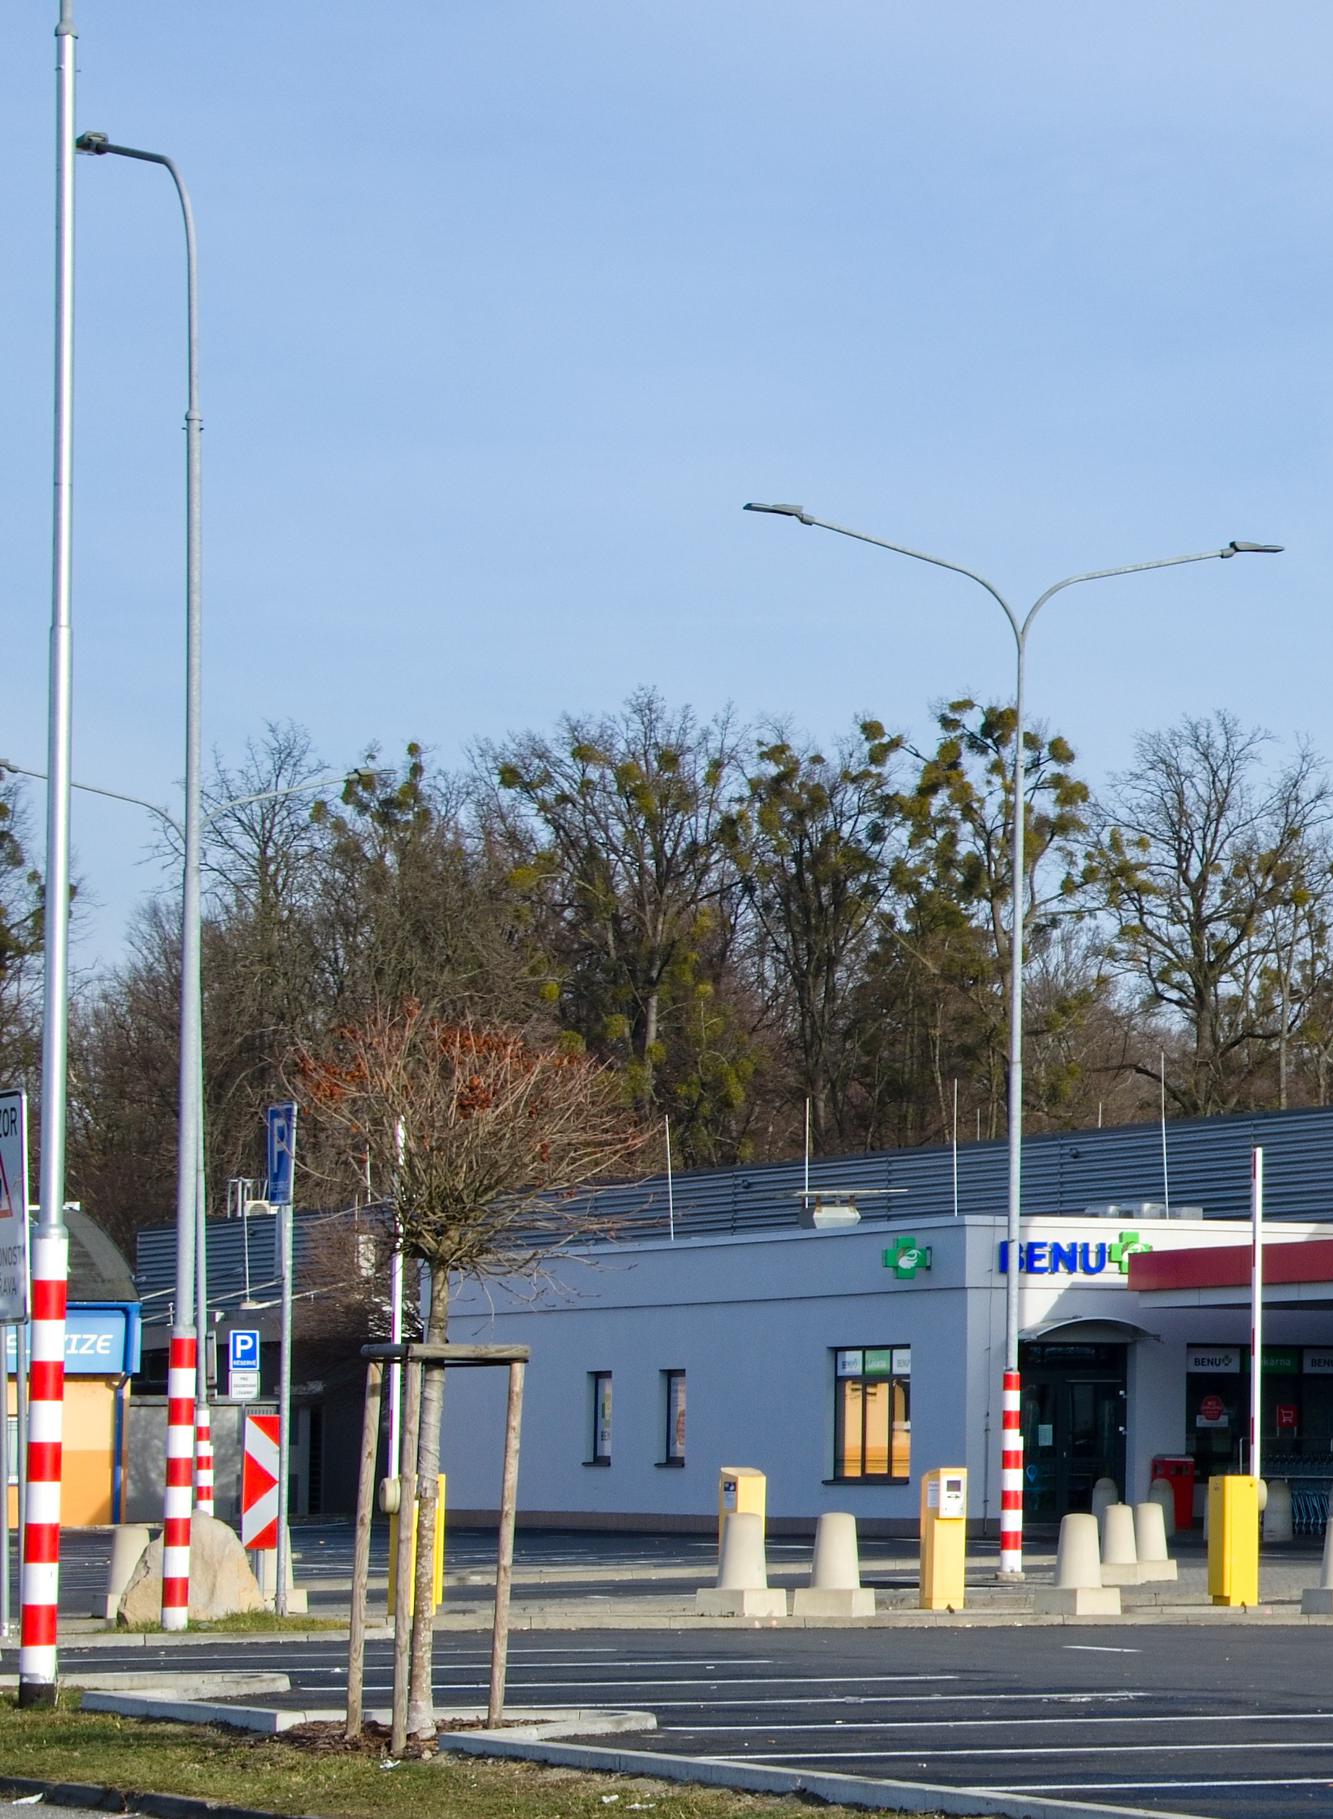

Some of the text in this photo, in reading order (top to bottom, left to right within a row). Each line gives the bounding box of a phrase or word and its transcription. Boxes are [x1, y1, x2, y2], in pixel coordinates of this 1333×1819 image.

[1000, 1240, 1106, 1275] BENU
[236, 1335, 253, 1358] P
[1194, 1357, 1222, 1367] BENU
